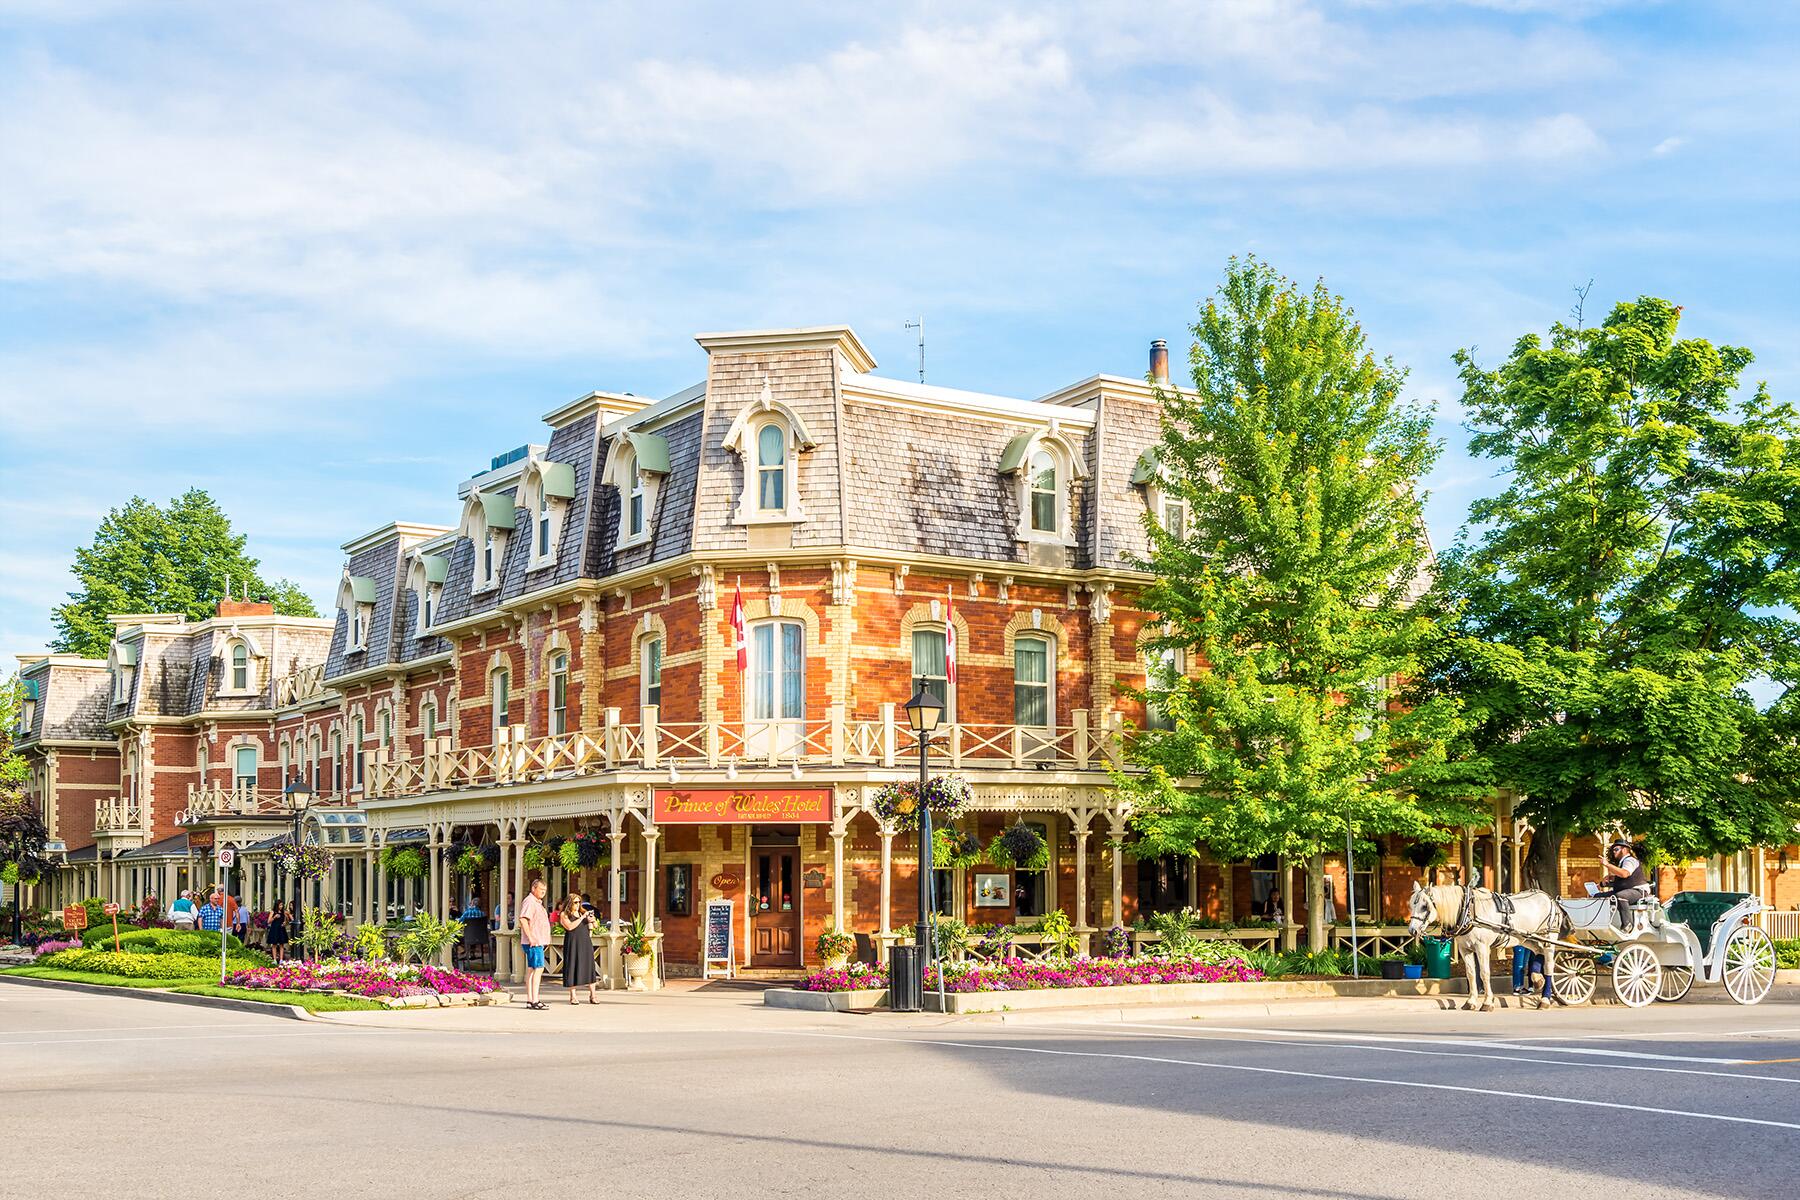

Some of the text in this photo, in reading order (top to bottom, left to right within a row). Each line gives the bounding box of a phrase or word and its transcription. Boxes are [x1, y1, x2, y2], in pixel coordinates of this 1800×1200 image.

[664, 795, 713, 813] Prince
[715, 795, 734, 816] of
[781, 794, 823, 812] Hotel
[714, 875, 736, 888] Open
